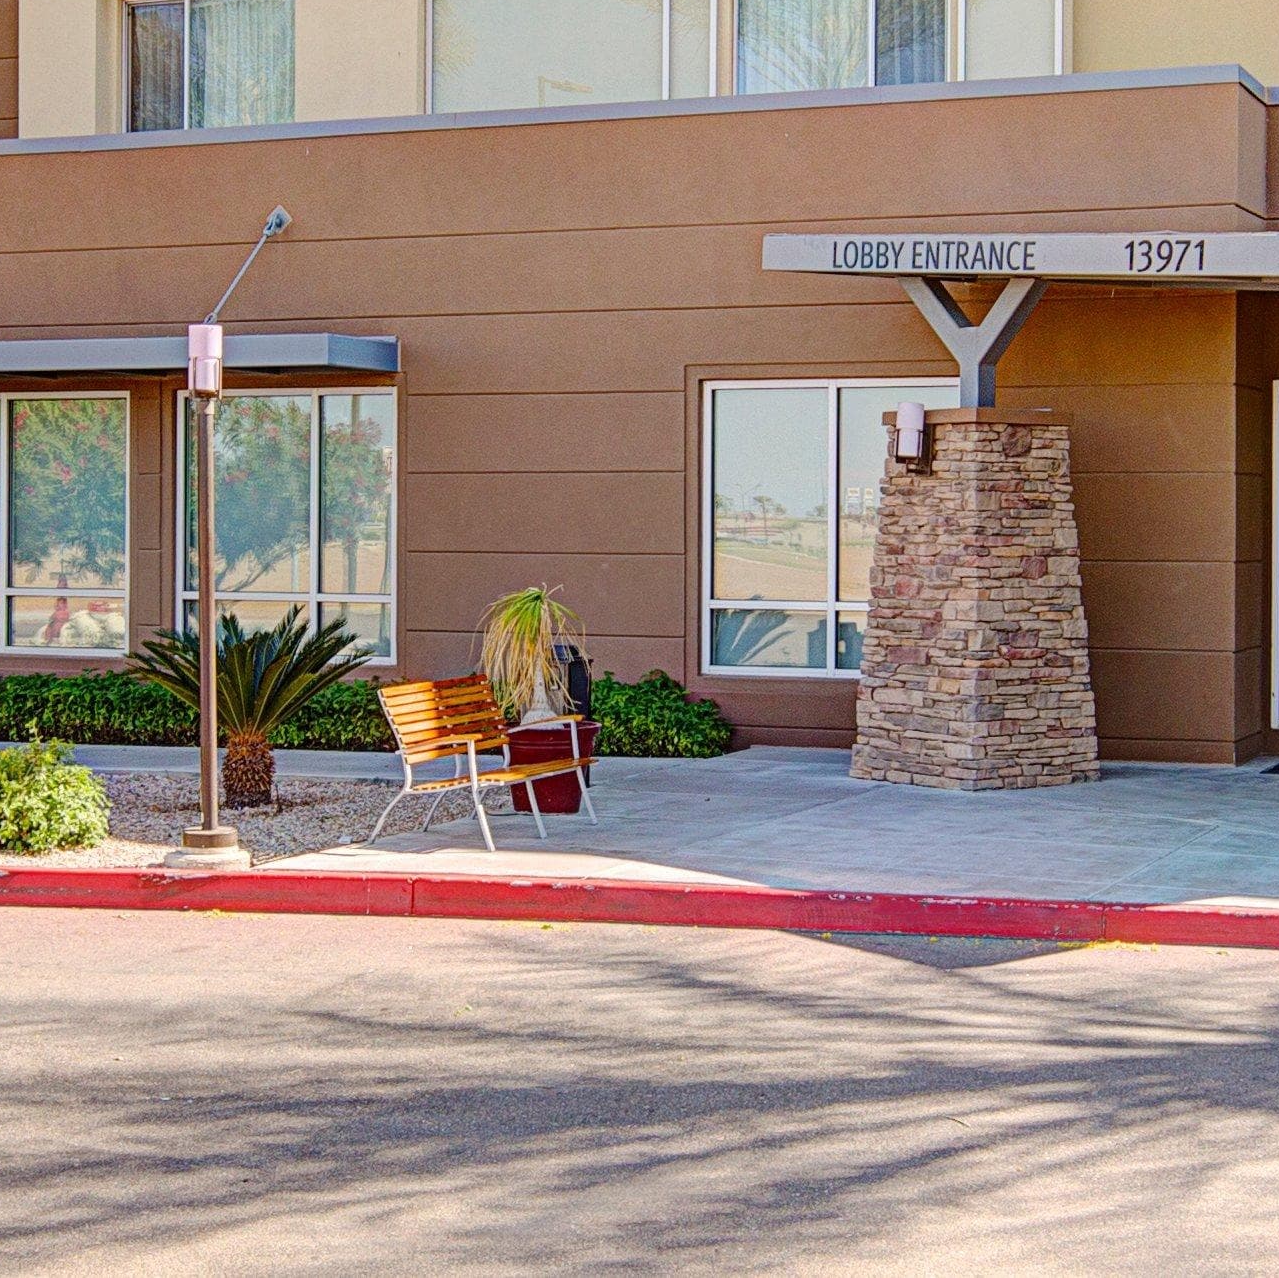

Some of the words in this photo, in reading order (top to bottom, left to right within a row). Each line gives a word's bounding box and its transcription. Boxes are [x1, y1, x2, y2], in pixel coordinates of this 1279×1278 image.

[832, 240, 905, 269] LOBBY
[912, 240, 1036, 271] ENTRANCE
[1124, 239, 1206, 271] 13971
